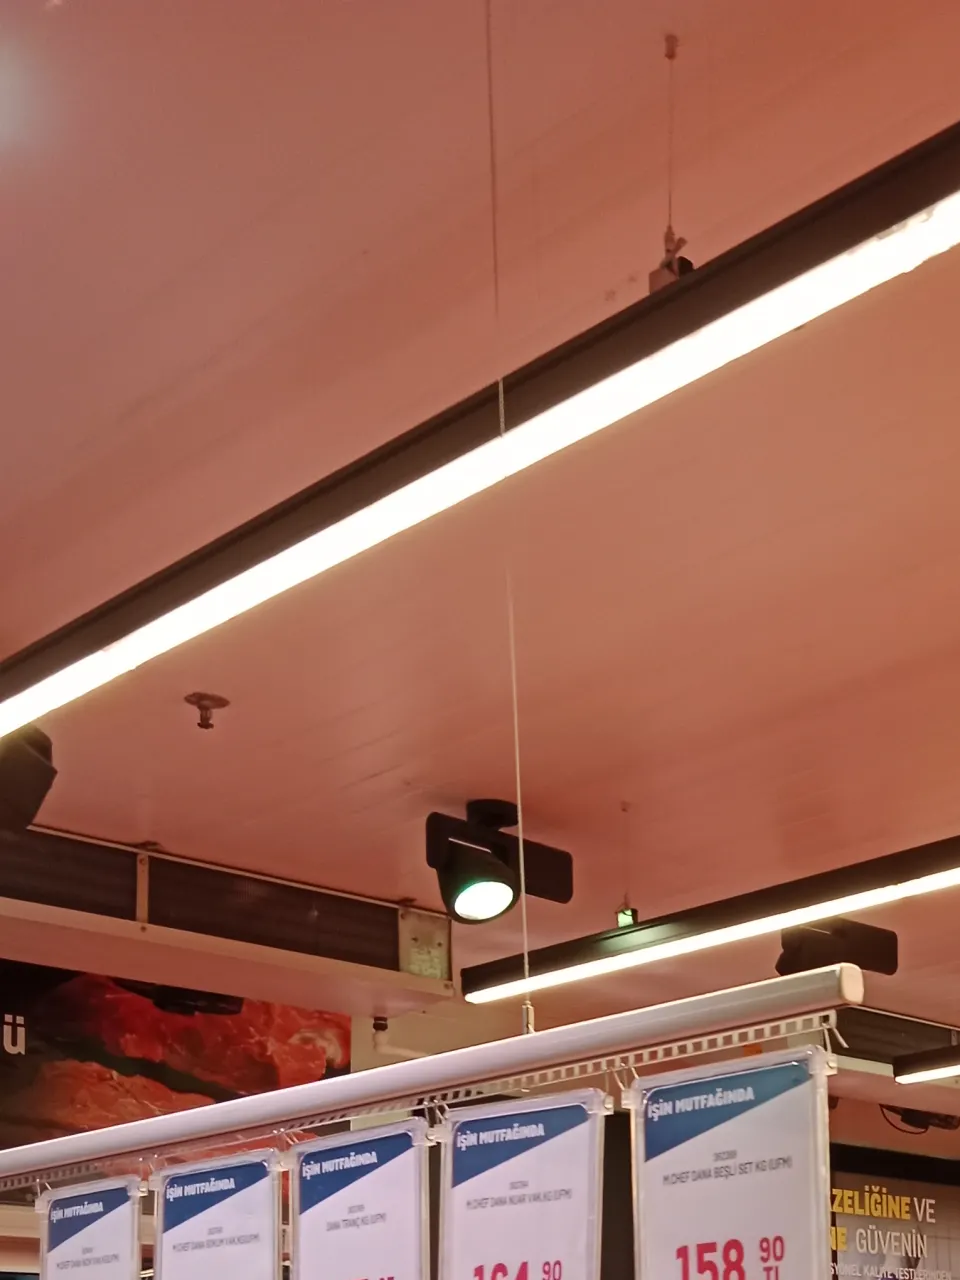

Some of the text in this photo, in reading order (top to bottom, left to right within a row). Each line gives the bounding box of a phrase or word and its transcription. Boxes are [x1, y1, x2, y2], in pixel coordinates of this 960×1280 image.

[675, 1087, 755, 1113] MUTFAĞINDA
[738, 1162, 753, 1175] SET
[755, 1160, 767, 1173] KG
[830, 1185, 936, 1223] ZELİĞİNE VE
[856, 1224, 927, 1258] GÜVENİN
